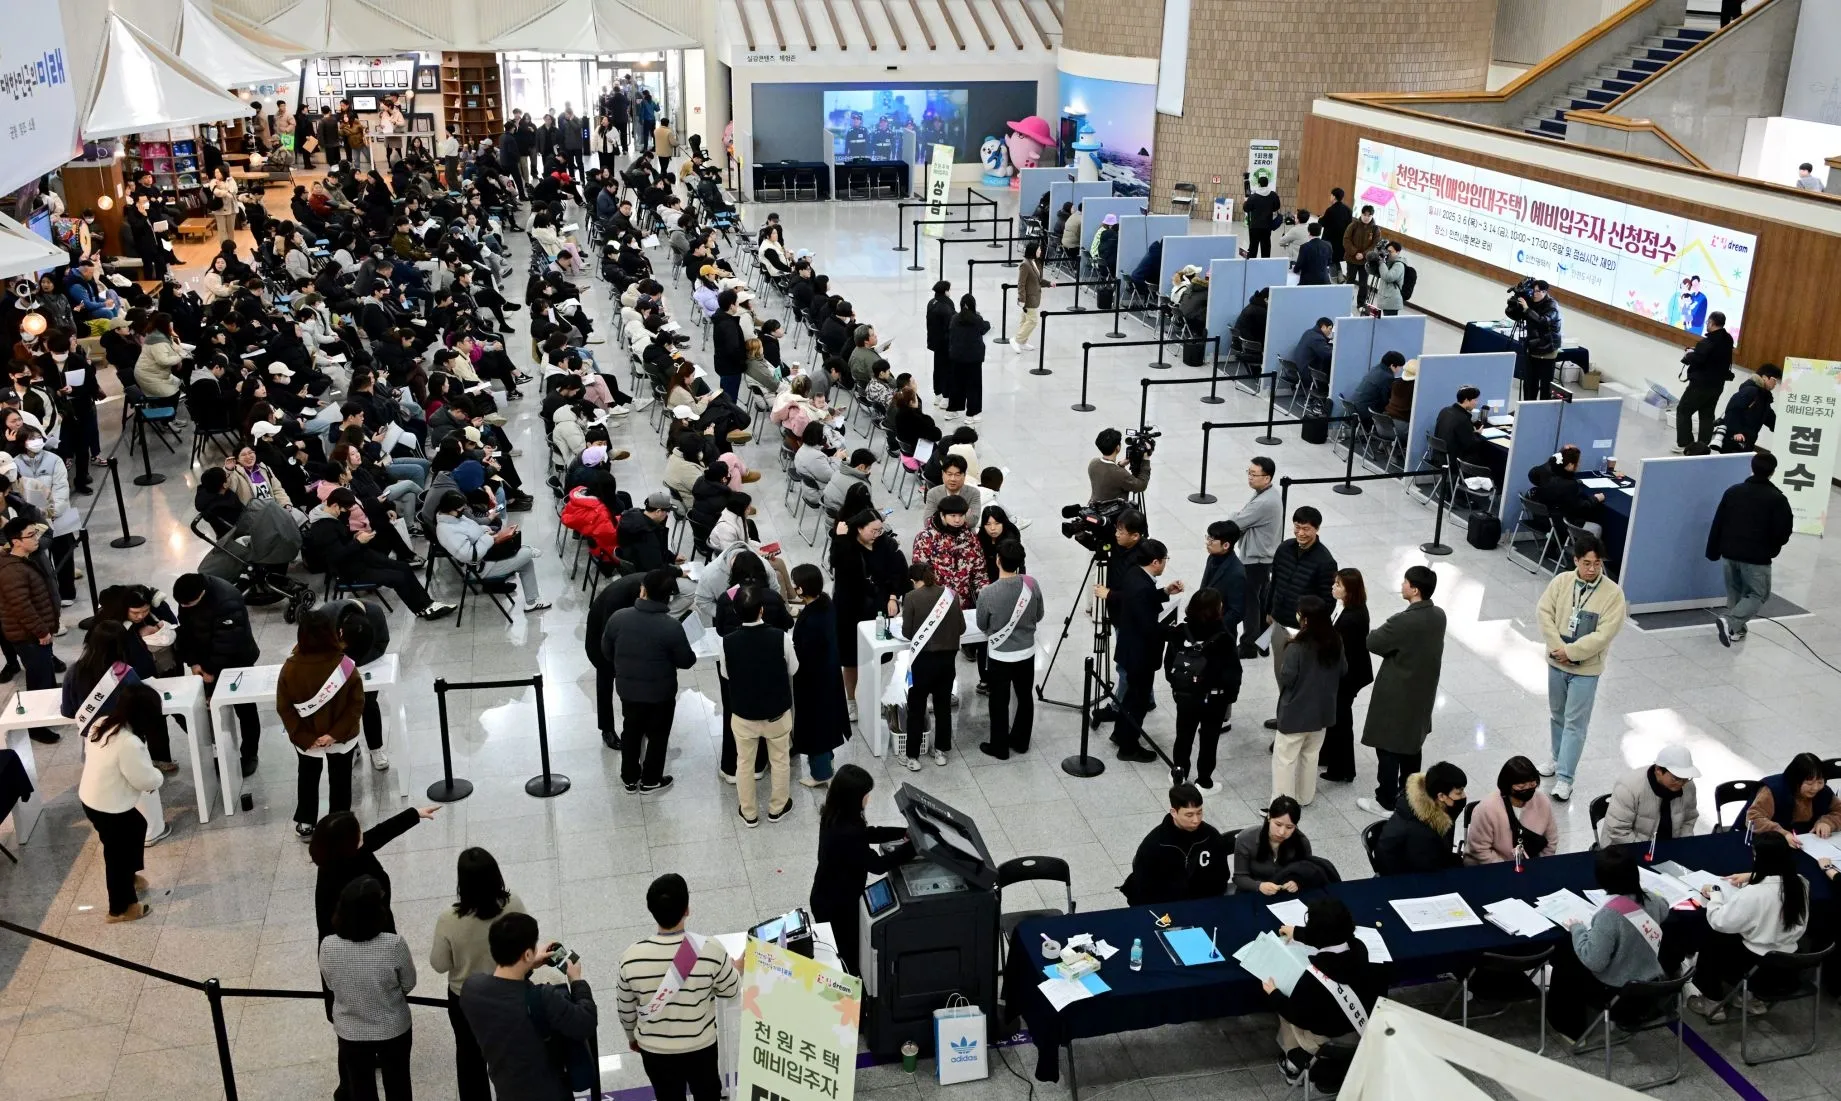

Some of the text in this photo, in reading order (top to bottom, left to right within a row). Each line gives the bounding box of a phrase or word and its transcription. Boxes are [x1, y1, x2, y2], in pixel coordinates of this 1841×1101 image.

[1396, 163, 1677, 263] 천원주택(매입임대주택) 예비입주자 신청접수
[1787, 393, 1837, 407] 천원주택
[1785, 404, 1835, 418] 예비입주자
[1199, 850, 1211, 867] C
[832, 982, 852, 994] dream
[754, 1020, 840, 1075] 천원주택
[951, 1054, 978, 1063] adidas
[753, 1046, 839, 1100] 예비입주자
